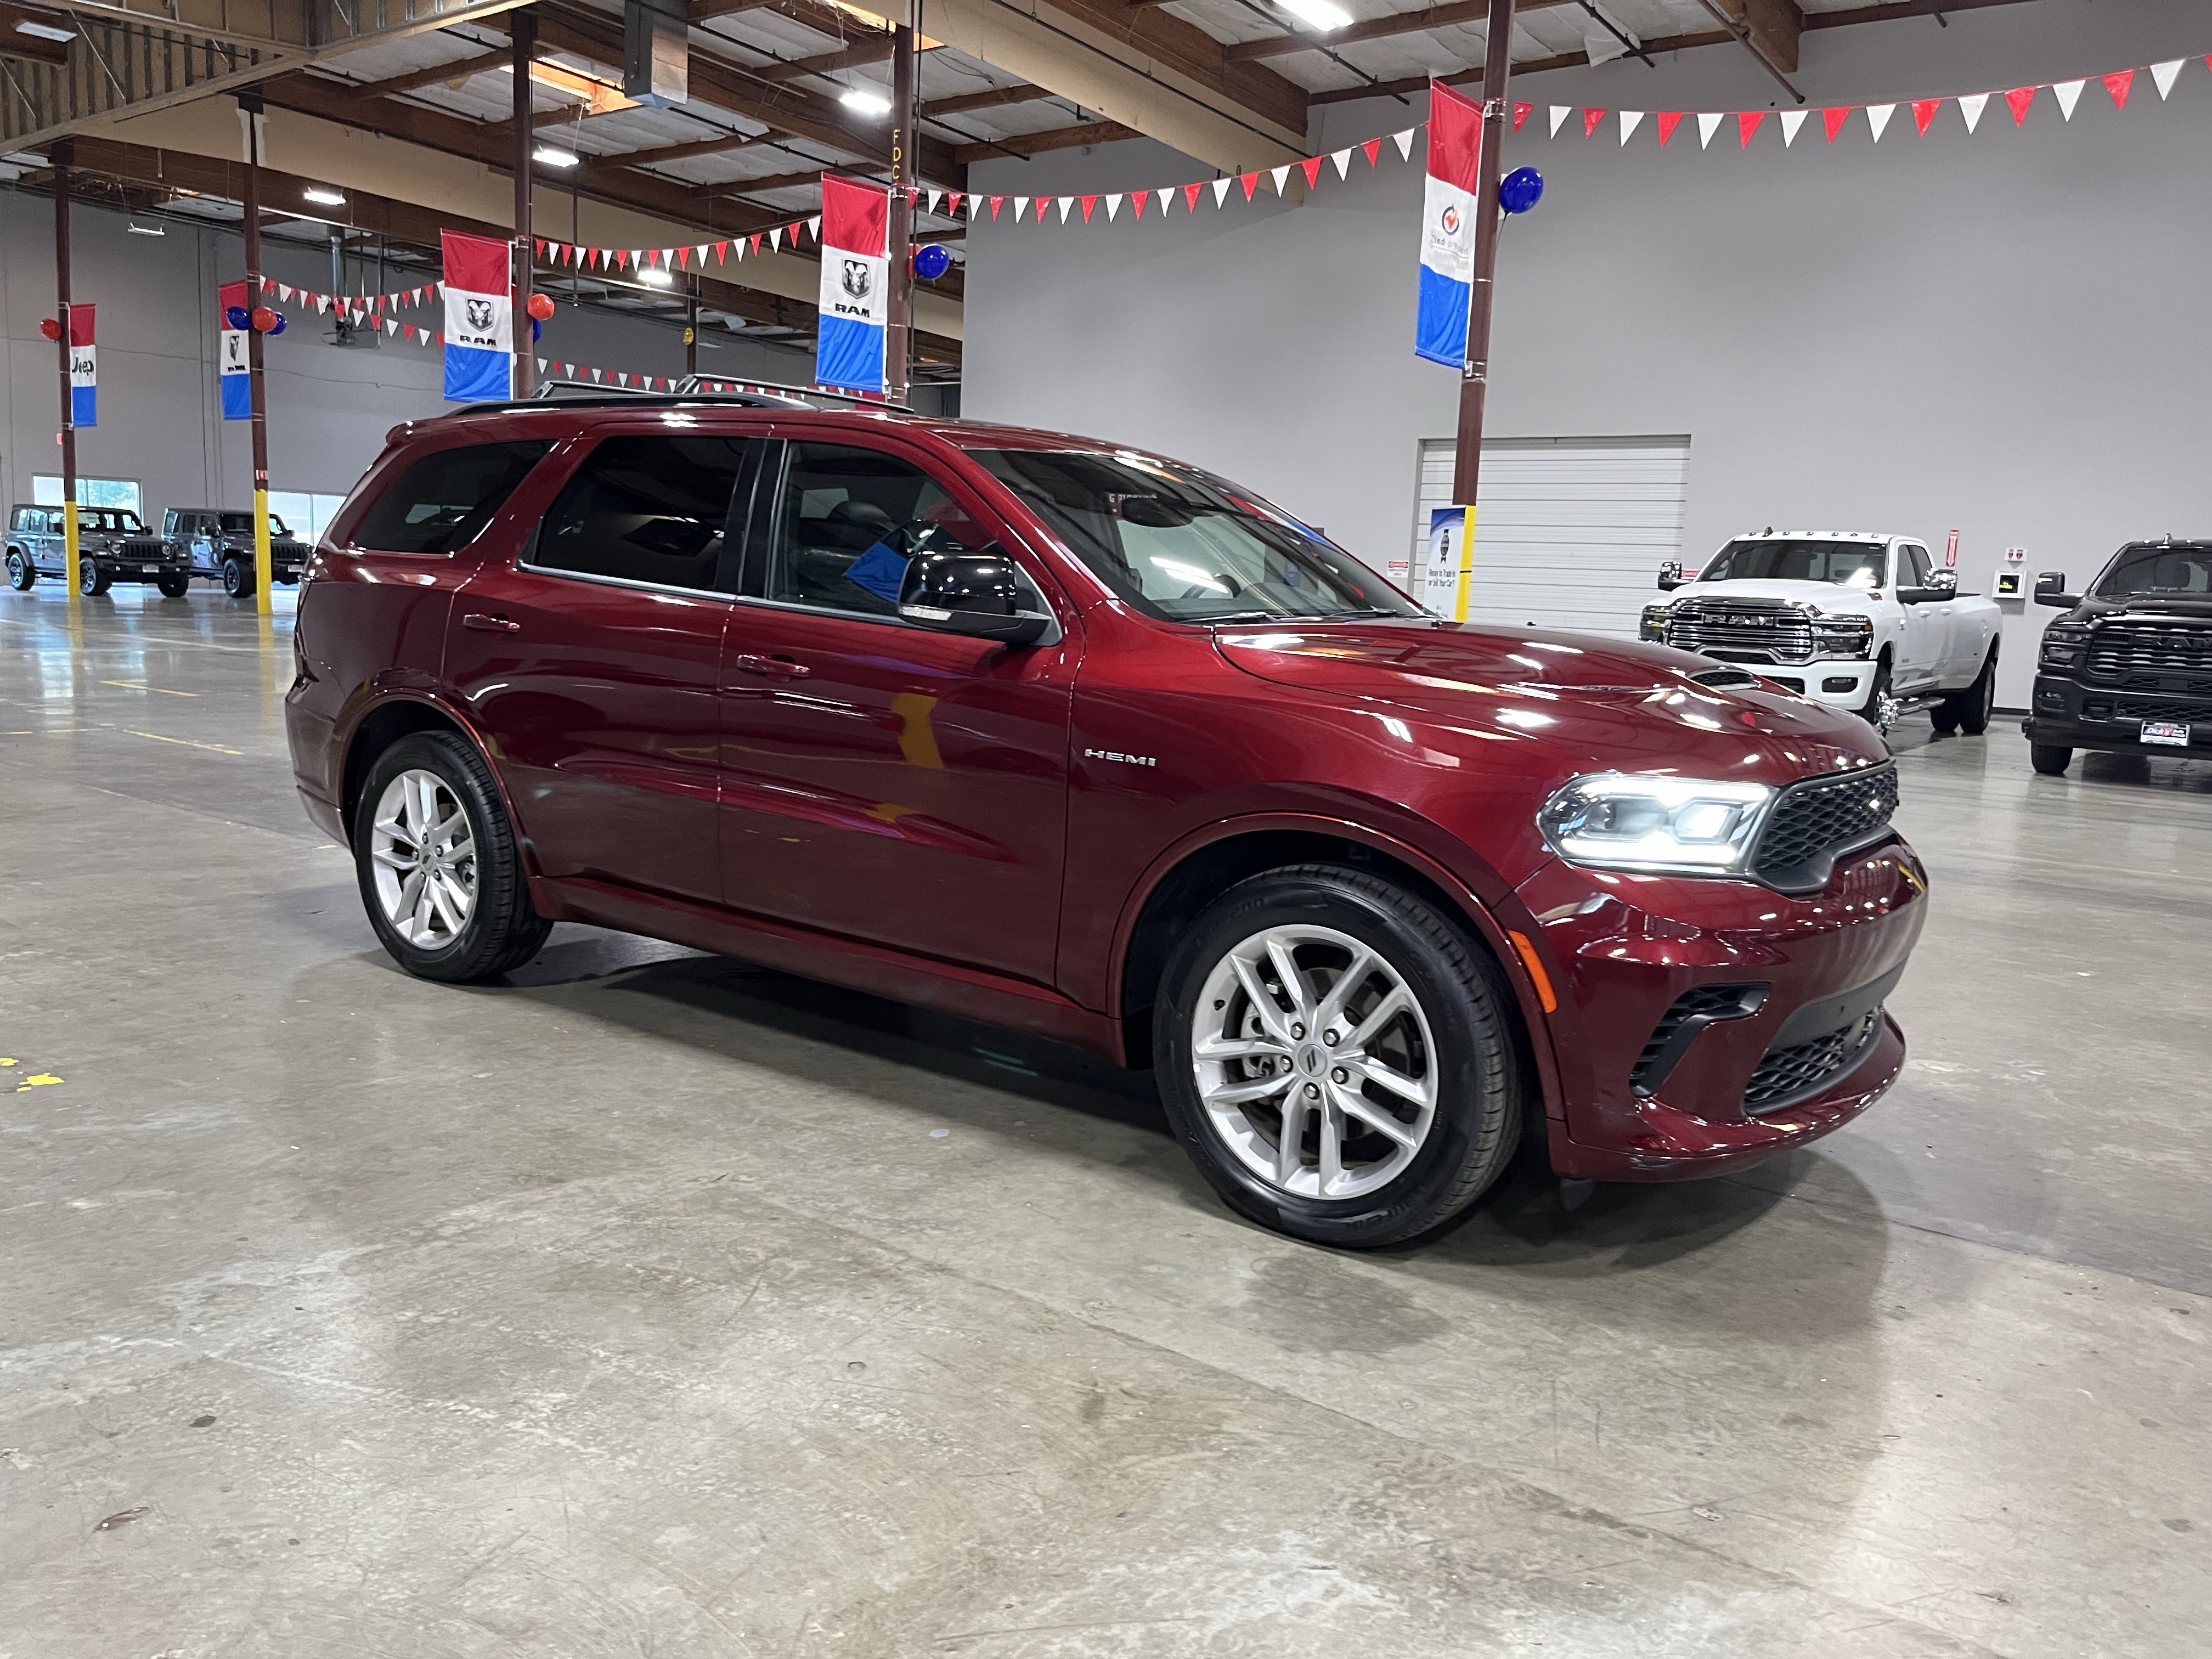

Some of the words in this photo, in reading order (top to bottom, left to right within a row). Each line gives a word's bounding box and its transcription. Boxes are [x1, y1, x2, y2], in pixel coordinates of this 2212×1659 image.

[893, 129, 901, 180] FDC
[835, 303, 870, 318] RAM
[460, 335, 496, 347] RAM
[1704, 613, 1774, 627] RAM
[1085, 748, 1156, 767] HEMI
